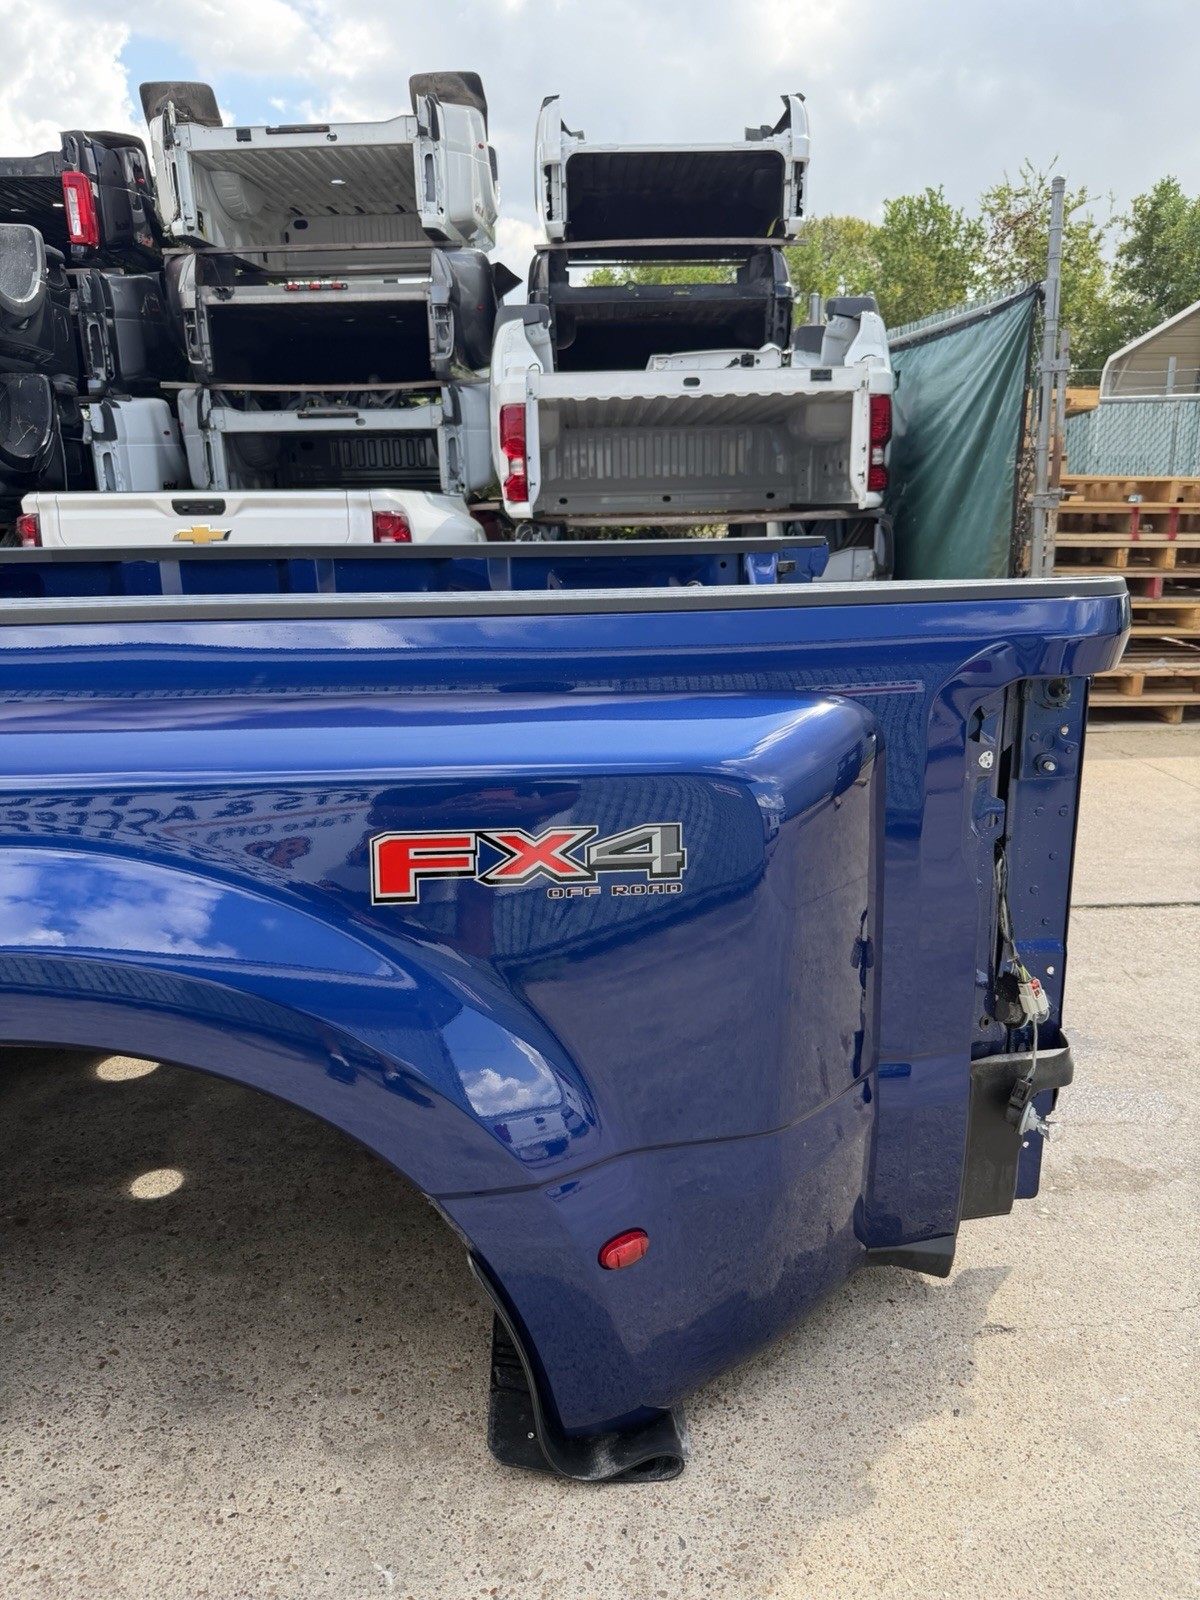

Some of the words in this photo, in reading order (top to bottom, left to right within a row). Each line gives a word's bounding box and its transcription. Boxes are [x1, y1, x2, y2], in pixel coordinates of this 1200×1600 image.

[369, 822, 687, 906] FX4
[547, 886, 601, 899] OFF
[611, 882, 683, 897] ROAD
